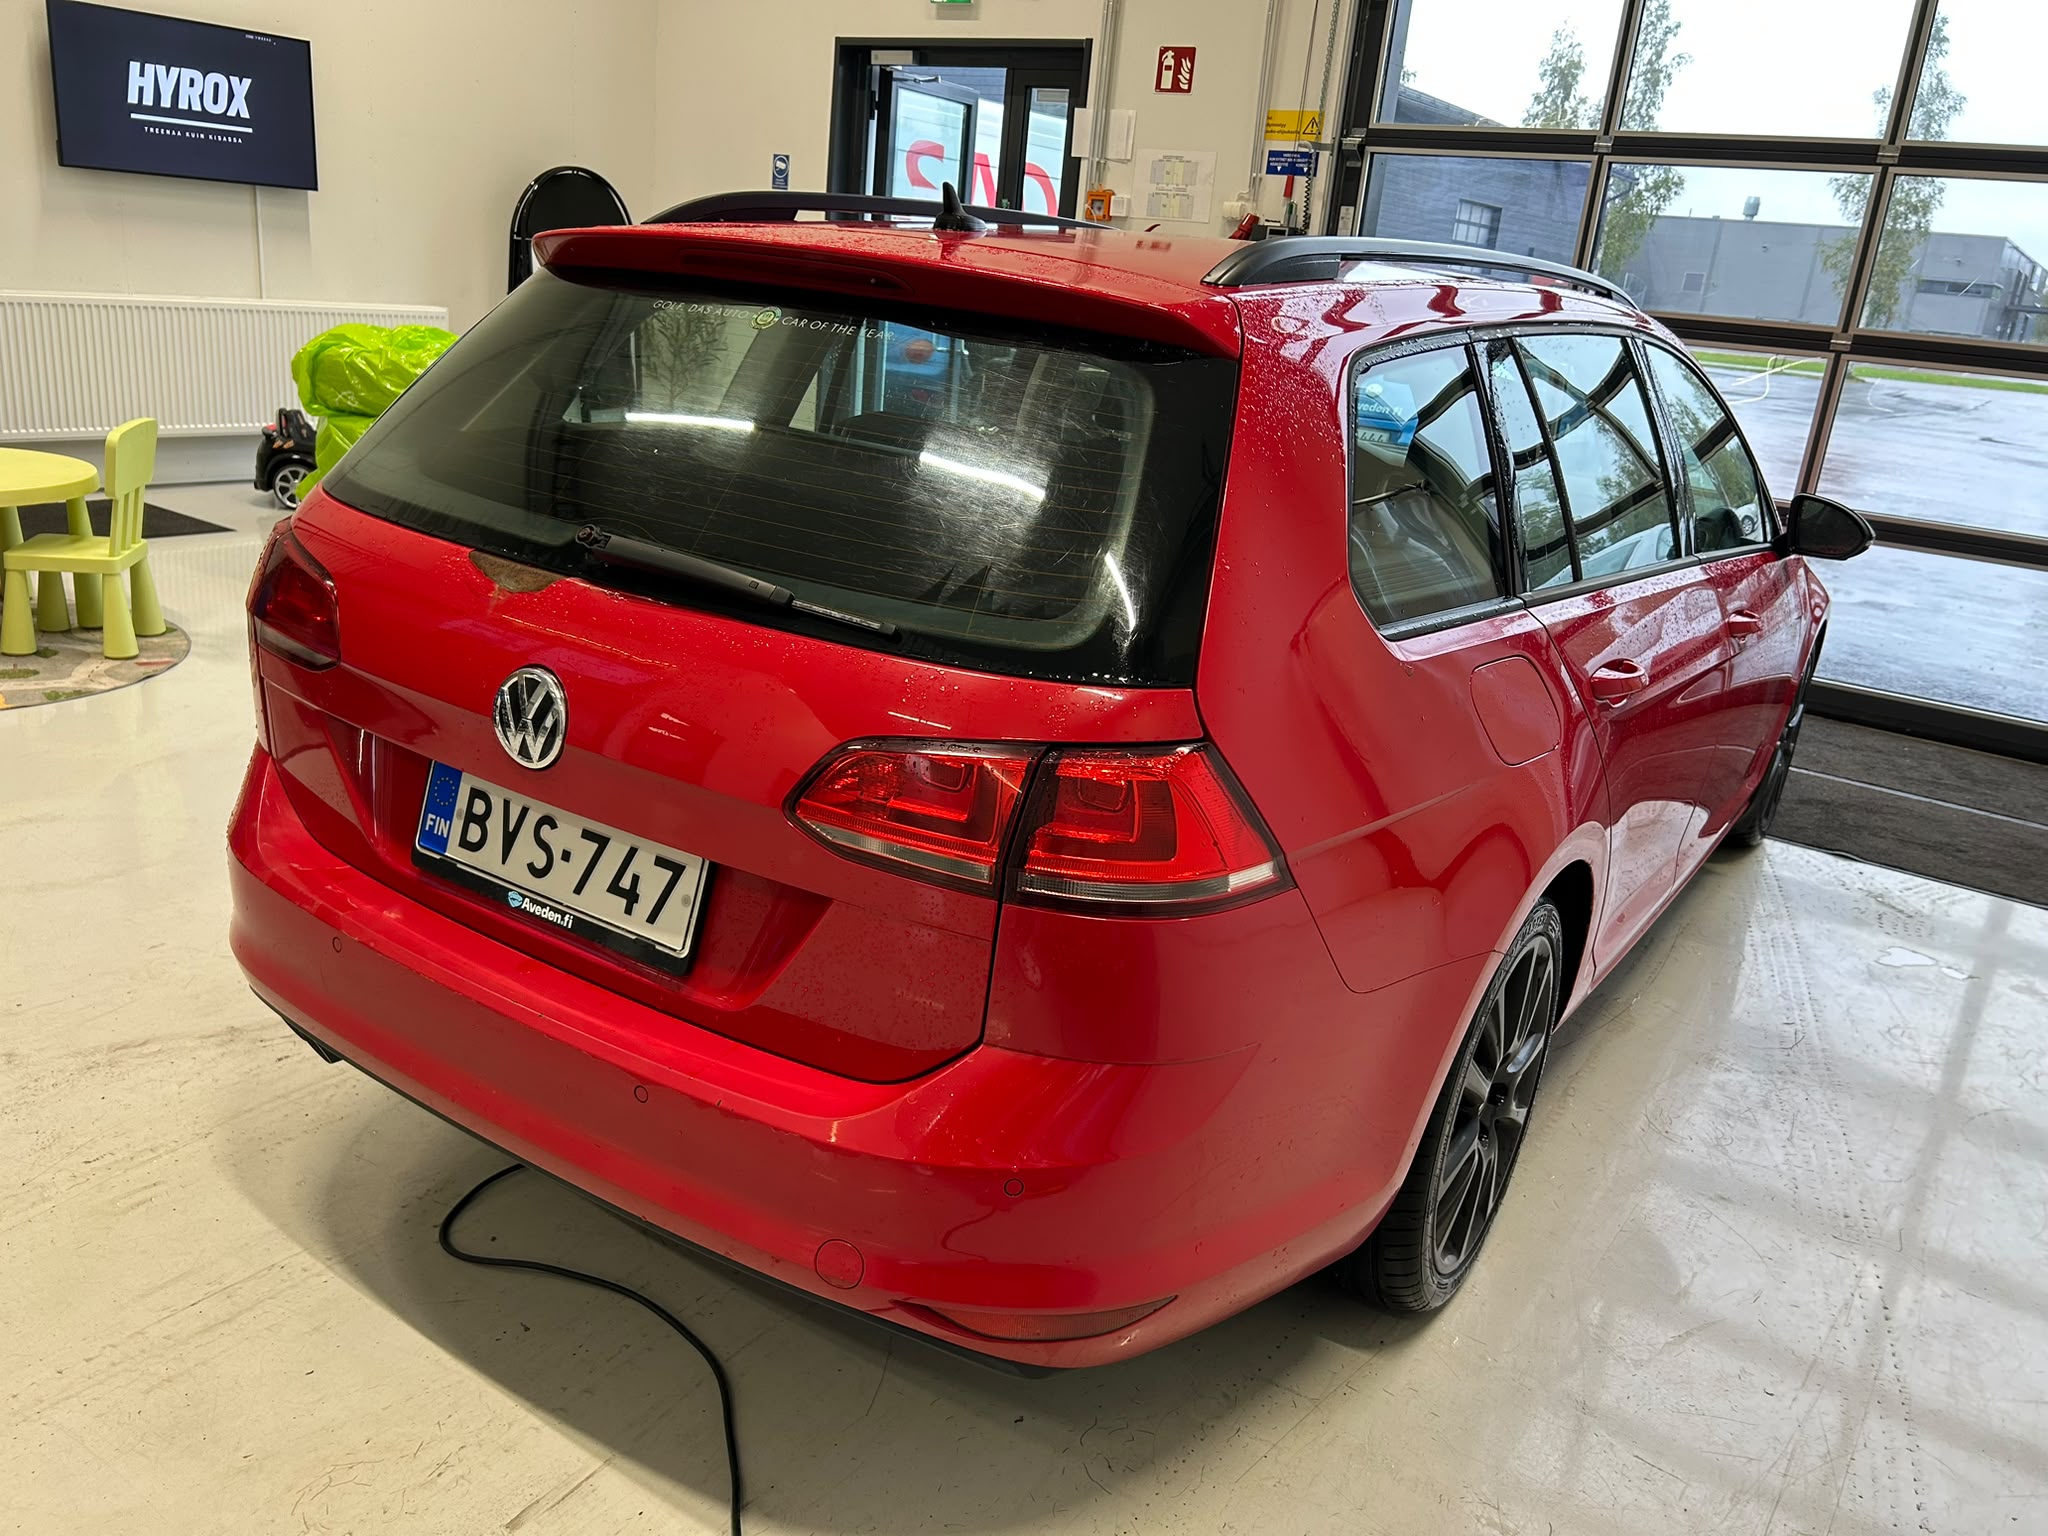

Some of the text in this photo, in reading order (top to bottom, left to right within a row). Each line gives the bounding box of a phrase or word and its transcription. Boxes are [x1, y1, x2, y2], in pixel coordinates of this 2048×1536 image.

[127, 61, 252, 119] HYROX
[144, 126, 243, 144] TREENAA KUIN KISASSA
[687, 303, 713, 315] DAS
[781, 316, 809, 328] CAR
[809, 320, 830, 331] OF
[830, 323, 857, 336] THE
[425, 786, 687, 925] FIN BVS-747
[521, 897, 574, 929] Aveden.fi
